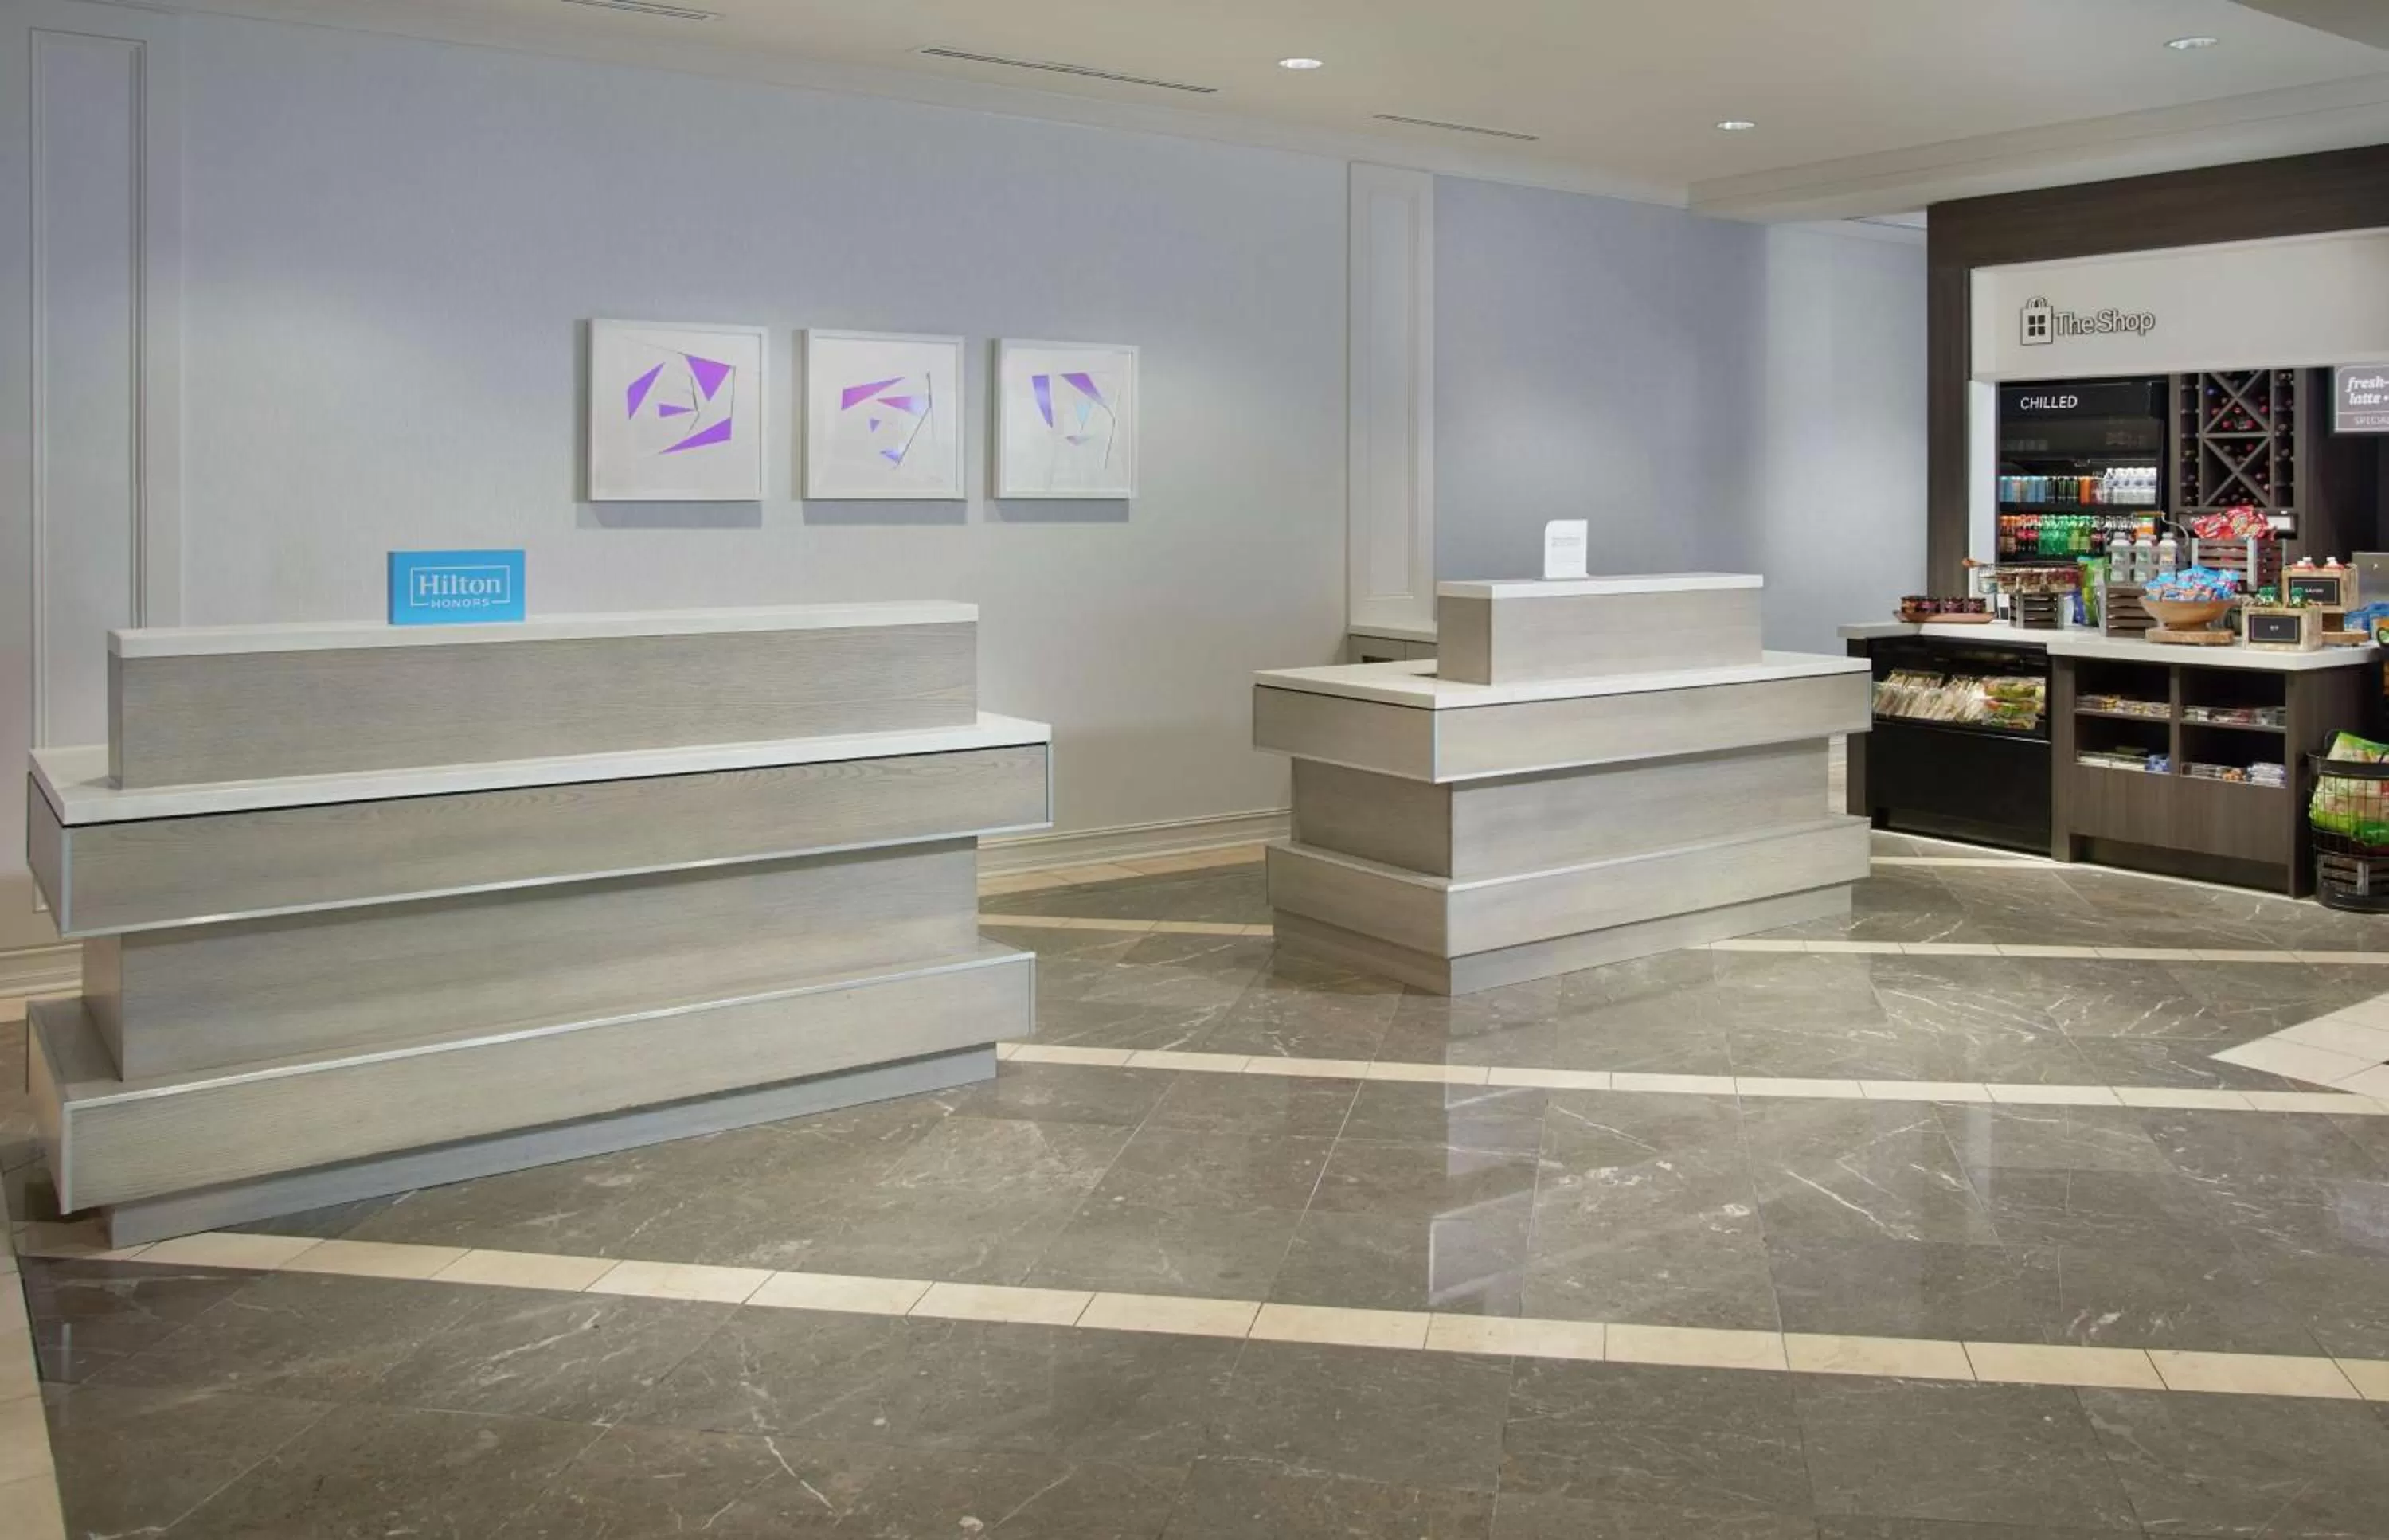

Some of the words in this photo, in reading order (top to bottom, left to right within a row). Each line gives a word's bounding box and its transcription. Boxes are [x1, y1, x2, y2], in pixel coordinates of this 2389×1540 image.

[2020, 396, 2078, 410] CHILLED
[420, 574, 501, 596] Hilton
[431, 598, 490, 608] HONORS
